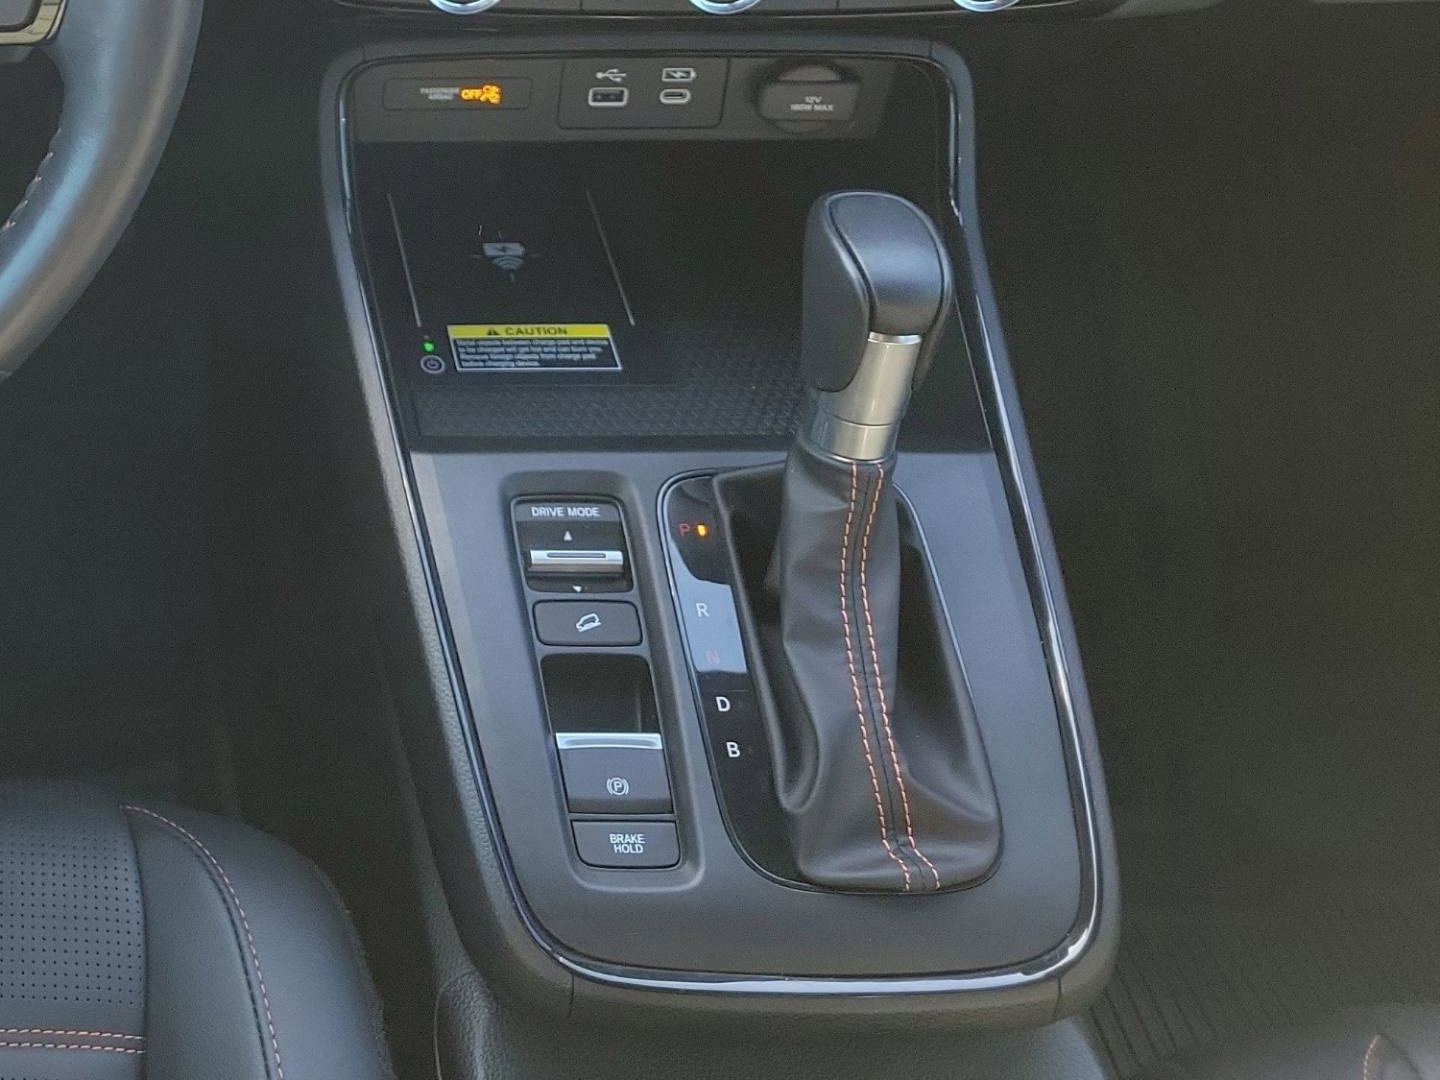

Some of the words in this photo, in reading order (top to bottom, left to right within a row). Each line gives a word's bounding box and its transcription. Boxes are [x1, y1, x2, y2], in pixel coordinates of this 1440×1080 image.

[461, 88, 483, 100] OFF
[504, 326, 568, 336] CAUTION
[531, 506, 565, 517] DRIVE
[567, 506, 601, 517] MODE
[679, 523, 690, 536] P
[696, 602, 710, 617] R
[706, 650, 721, 664] N
[716, 696, 731, 712] D
[726, 741, 741, 758] B
[609, 833, 645, 844] BRAKE
[613, 844, 644, 854] HOLD
